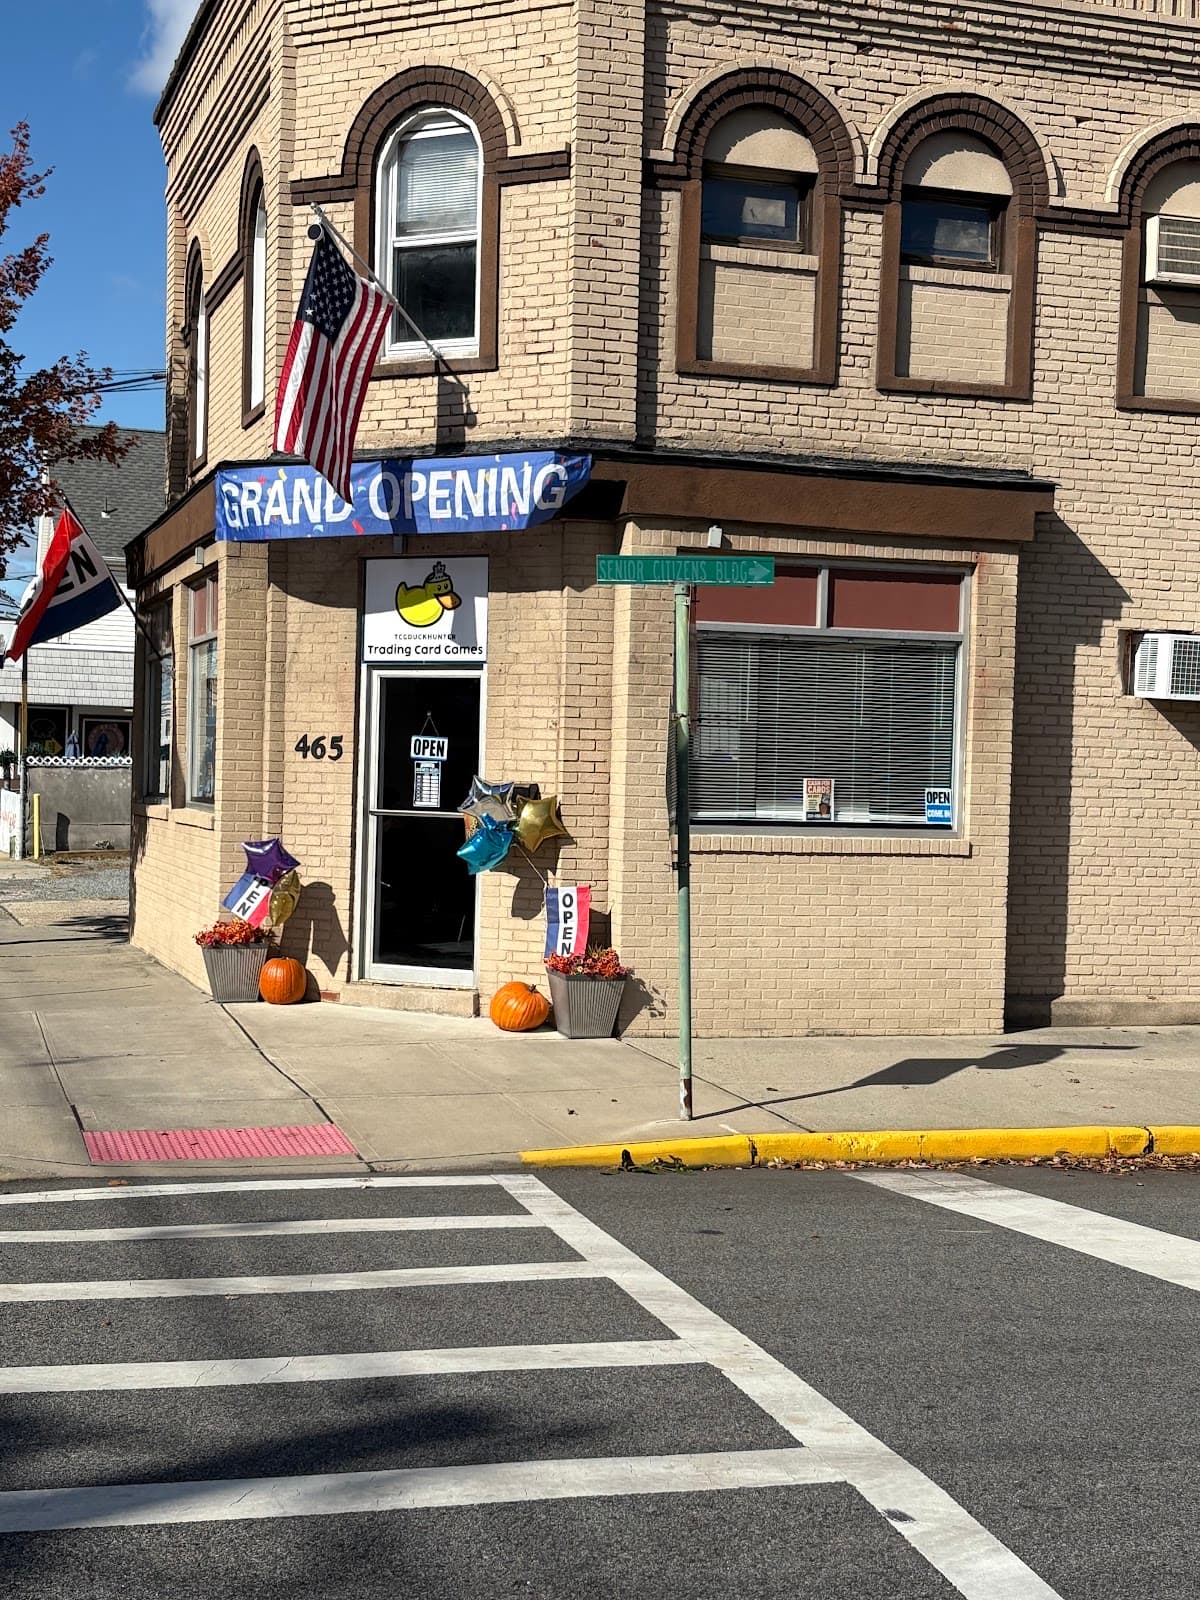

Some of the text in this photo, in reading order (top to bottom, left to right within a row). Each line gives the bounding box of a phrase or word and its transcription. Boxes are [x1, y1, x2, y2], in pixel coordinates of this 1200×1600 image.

[221, 462, 569, 532] GRAND OPENING
[600, 560, 748, 581] SENIOR CITIZENS BLDG
[368, 644, 483, 657] Trading Card Games
[294, 733, 344, 761] 465
[413, 738, 445, 757] OPEN
[807, 785, 831, 794] CARDS
[926, 791, 950, 804] OPEN
[237, 876, 269, 917] PEN
[561, 893, 574, 955] OPEN
